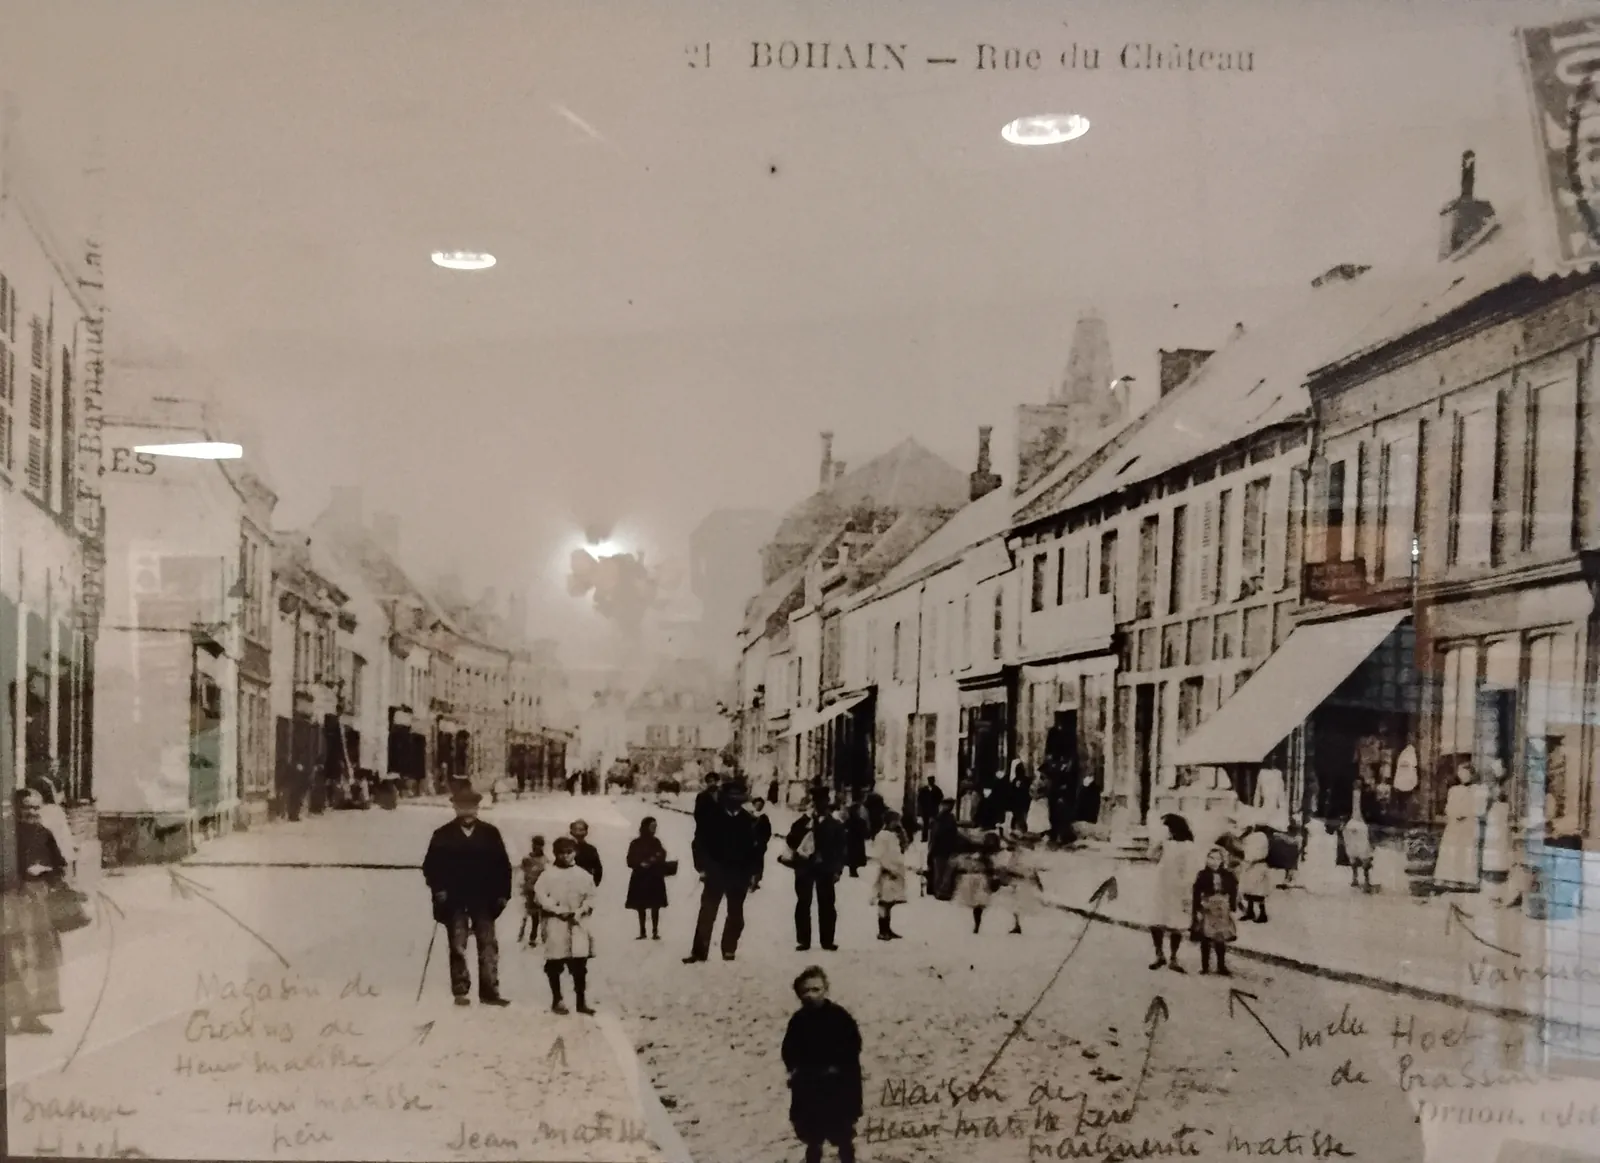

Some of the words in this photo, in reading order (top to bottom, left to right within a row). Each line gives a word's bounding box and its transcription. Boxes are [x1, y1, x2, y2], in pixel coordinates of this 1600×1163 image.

[750, 41, 908, 71] BOHAIN
[975, 42, 1042, 71] Rue
[1060, 41, 1101, 71] du
[1119, 41, 1256, 72] Château
